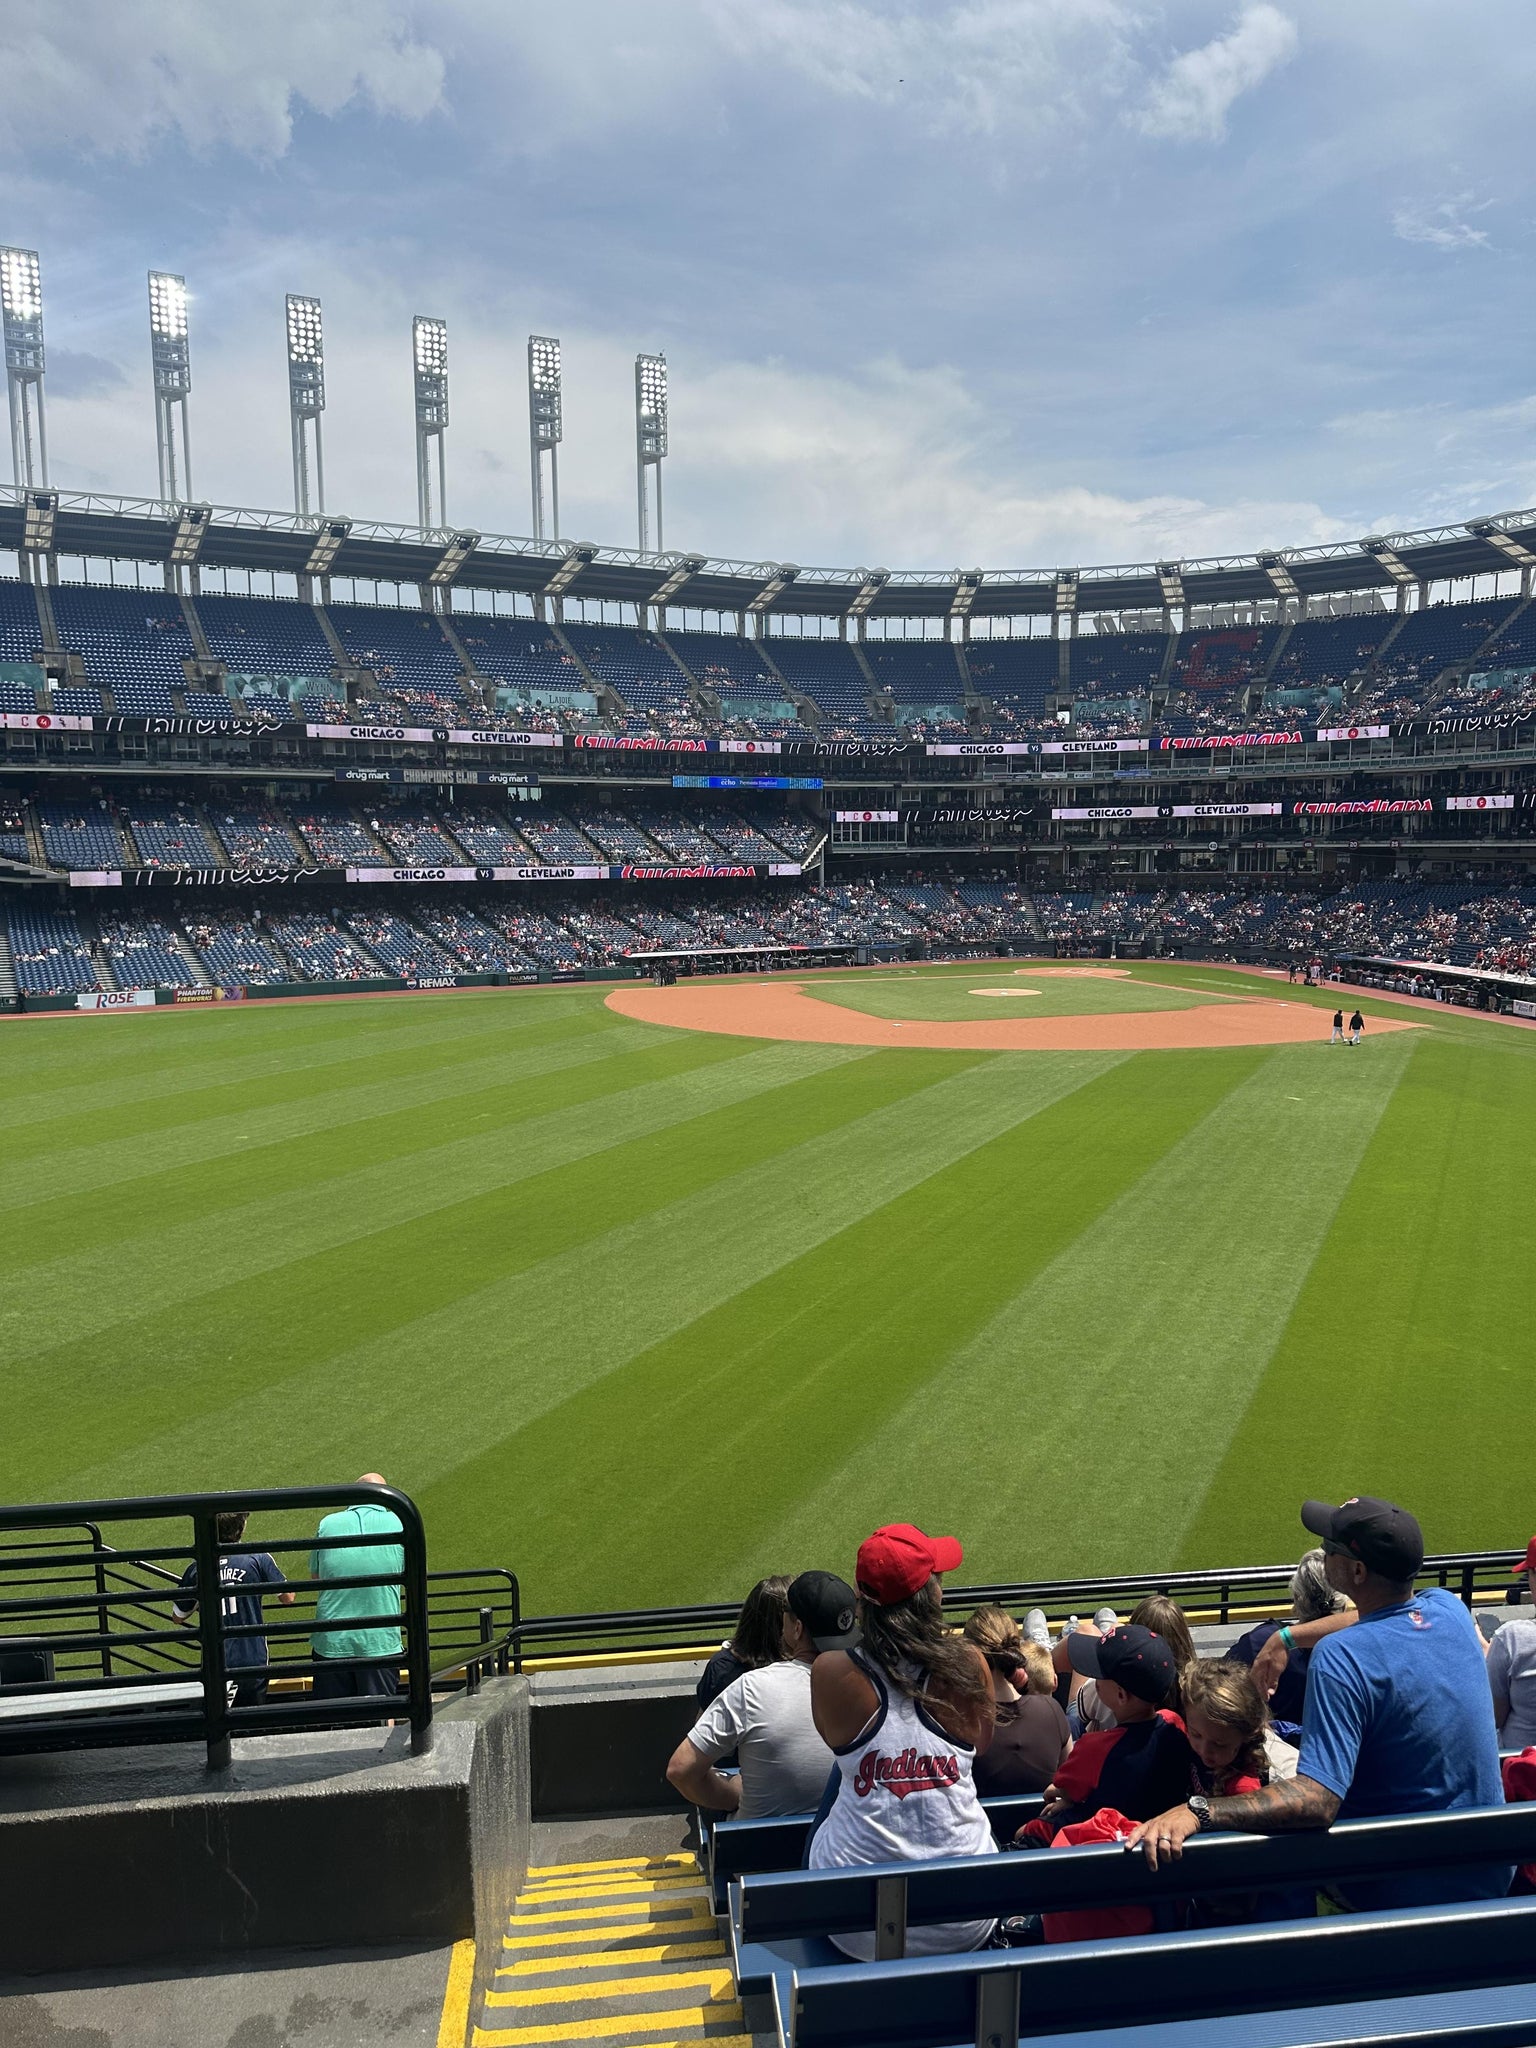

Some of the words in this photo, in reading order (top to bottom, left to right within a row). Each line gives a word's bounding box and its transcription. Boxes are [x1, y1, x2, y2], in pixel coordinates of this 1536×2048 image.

[350, 728, 405, 739] CHICAGO
[437, 732, 446, 740] VS
[472, 733, 531, 744] CLEVELAND
[960, 745, 1004, 754] CHICAGO
[1062, 742, 1117, 752] CLEVELAND
[346, 771, 367, 781] drug
[368, 771, 390, 780] mart
[403, 770, 454, 784] CHAMPIONS
[456, 771, 478, 785] CLUB
[488, 774, 508, 785] drug
[509, 774, 528, 783] mart
[1087, 809, 1132, 818] CHICAGO
[1194, 805, 1249, 815] CLEVELAND
[393, 870, 445, 880] CHICAGO
[480, 870, 489, 878] VS
[518, 869, 574, 878] CLEVELAND
[177, 989, 213, 997] PHANTOM
[177, 995, 213, 1003] FIREWORKS
[96, 992, 135, 1008] ROSE
[854, 1747, 960, 1797] Indians
